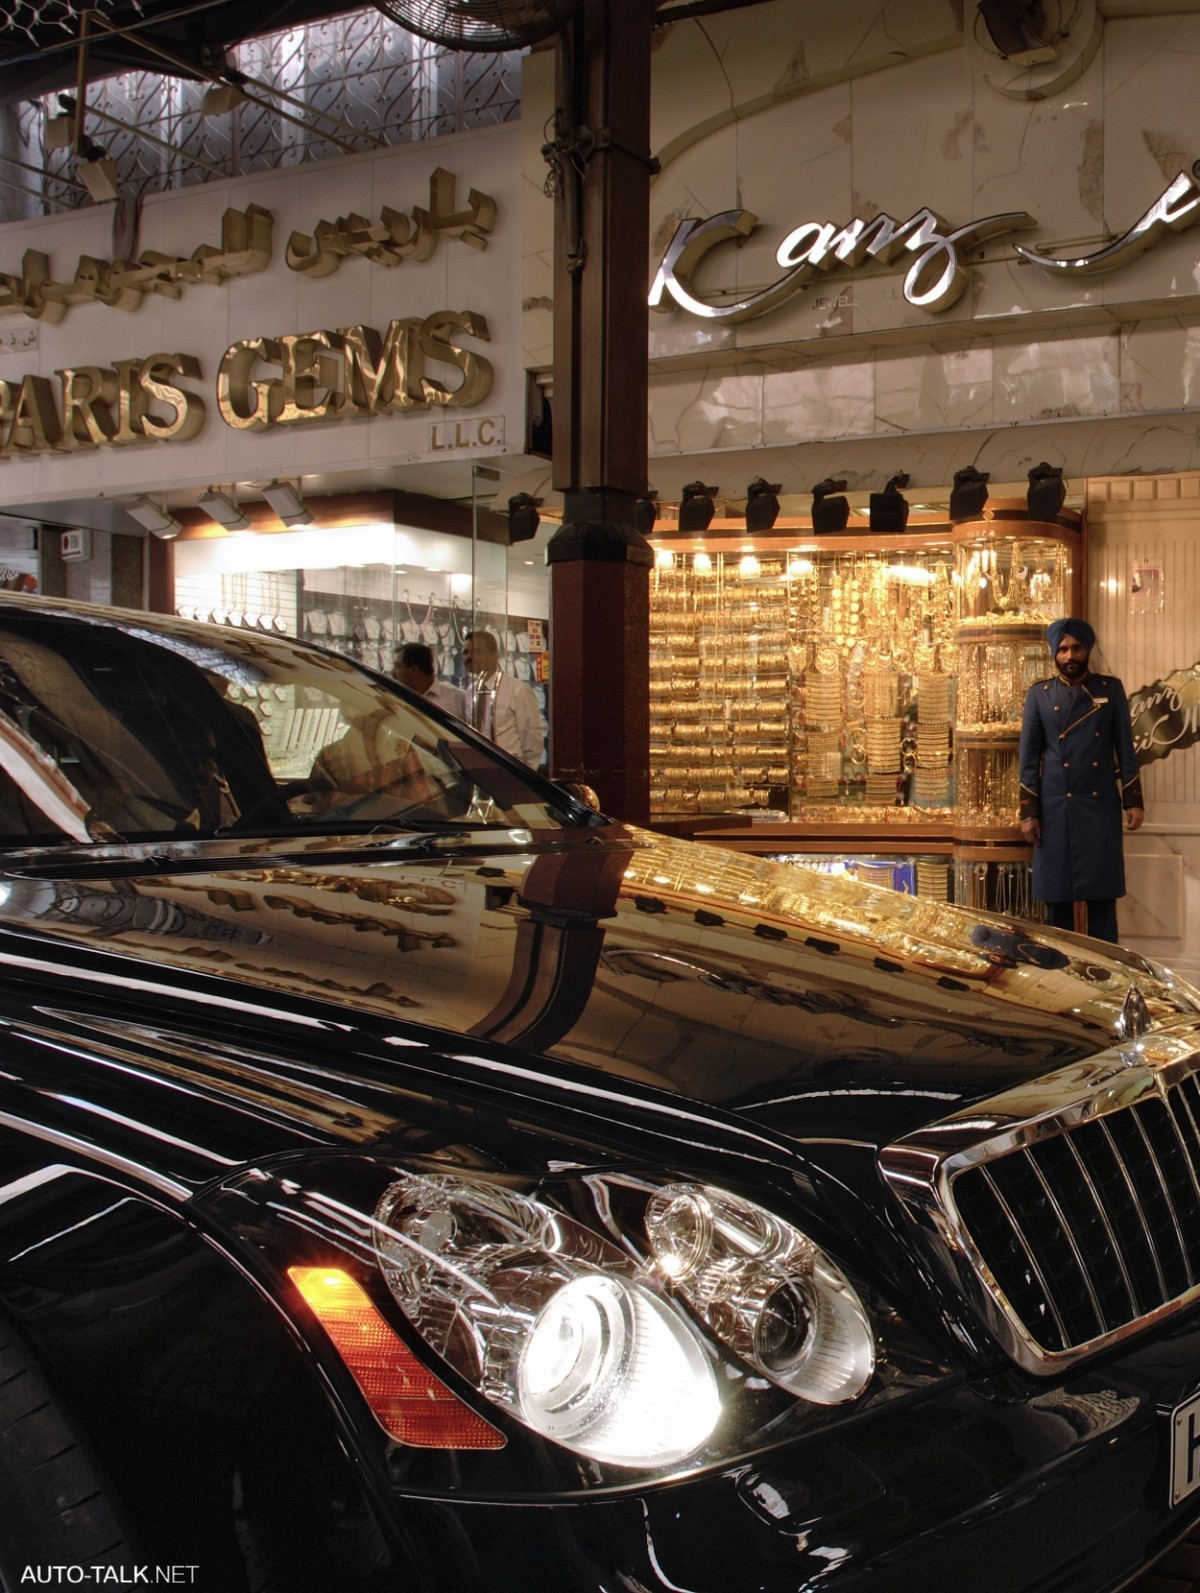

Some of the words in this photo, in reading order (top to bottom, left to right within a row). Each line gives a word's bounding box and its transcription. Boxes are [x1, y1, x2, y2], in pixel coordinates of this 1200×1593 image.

[648, 207, 1038, 325] Kanz
[217, 310, 495, 432] GEMS
[430, 418, 502, 451] L.L.C.
